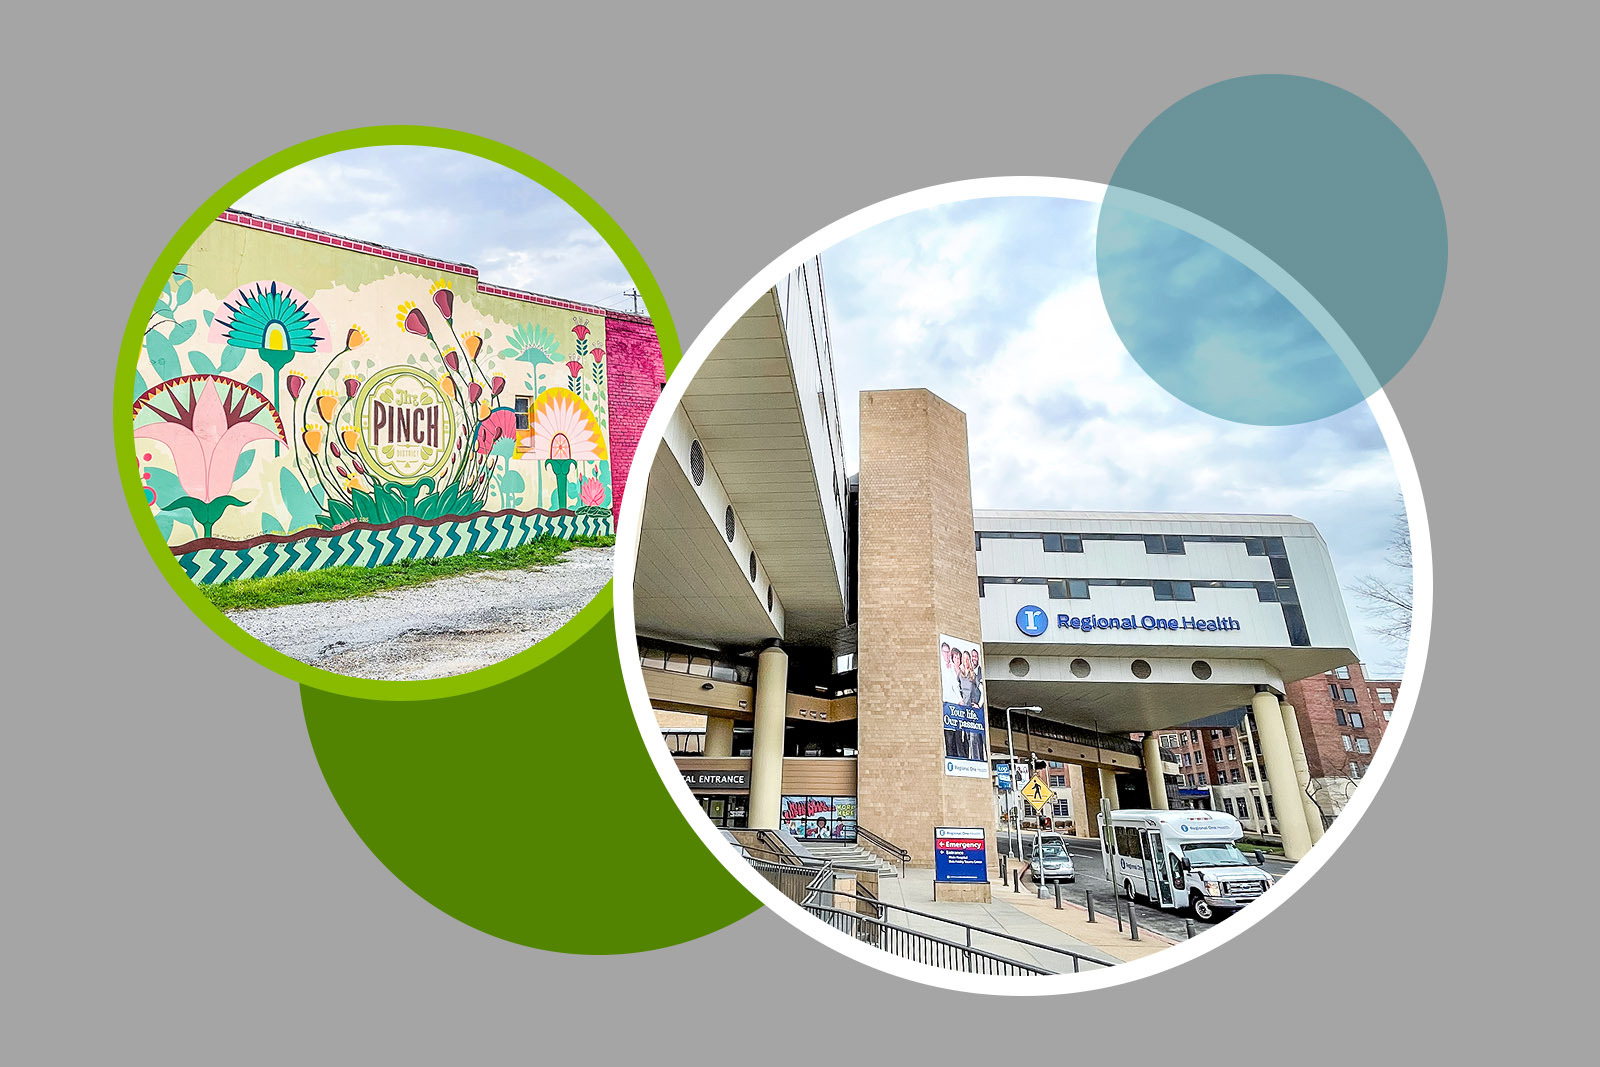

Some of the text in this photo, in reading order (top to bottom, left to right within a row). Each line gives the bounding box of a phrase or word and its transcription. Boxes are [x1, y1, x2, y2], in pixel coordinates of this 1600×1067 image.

[396, 389, 419, 406] The
[374, 400, 439, 448] PINCH
[1057, 614, 1241, 632] Regional One Health
[949, 705, 966, 718] Your
[944, 714, 958, 727] Our
[699, 775, 745, 784] ENTRANCE
[946, 841, 981, 850] Emergency
